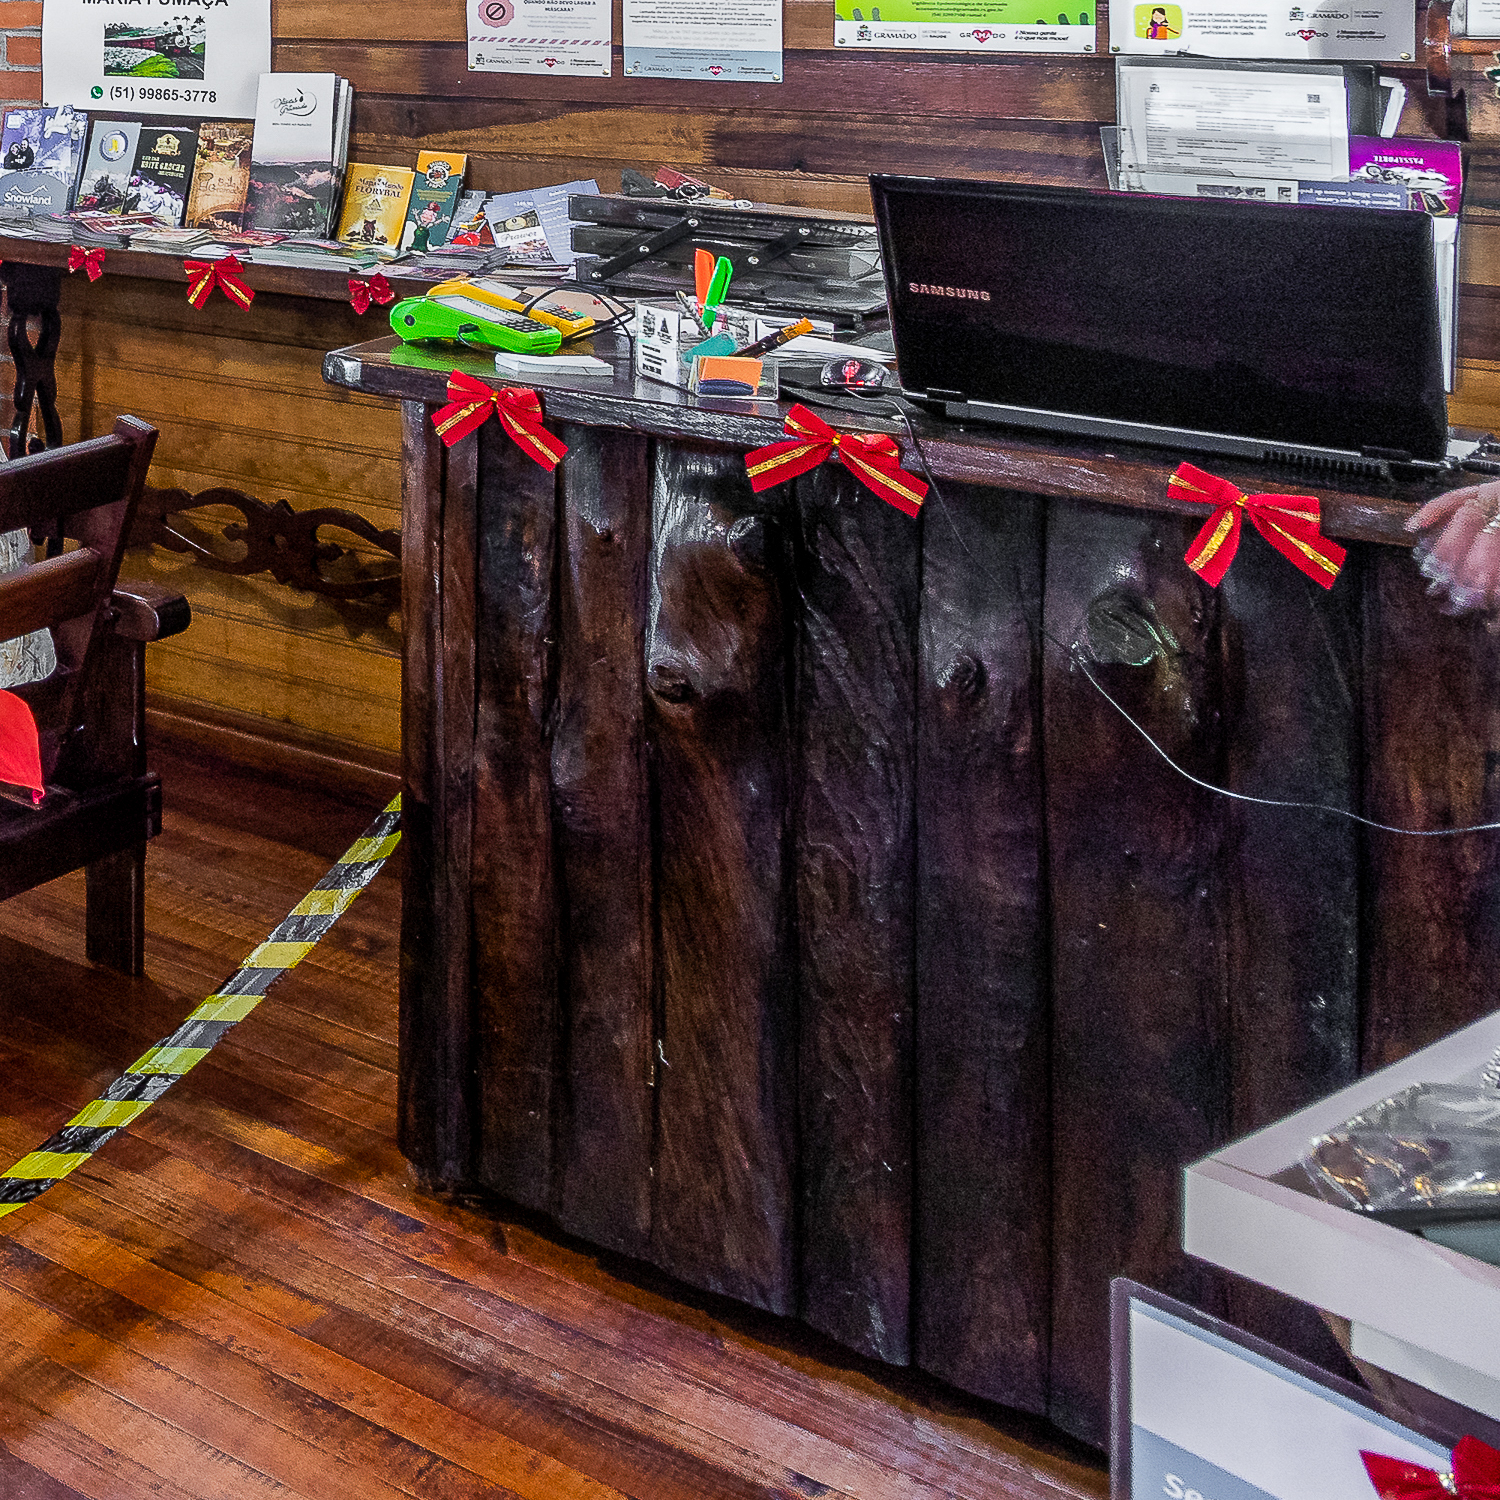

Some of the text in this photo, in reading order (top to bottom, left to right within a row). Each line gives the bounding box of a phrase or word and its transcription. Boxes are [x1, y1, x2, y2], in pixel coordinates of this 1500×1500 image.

[109, 85, 217, 103] (51) 99865-3778
[1372, 155, 1425, 165] PASSAPORTE
[3, 191, 53, 206] Snowland
[355, 185, 402, 198] FLORYBAL
[909, 282, 991, 301] SAMSUNG
